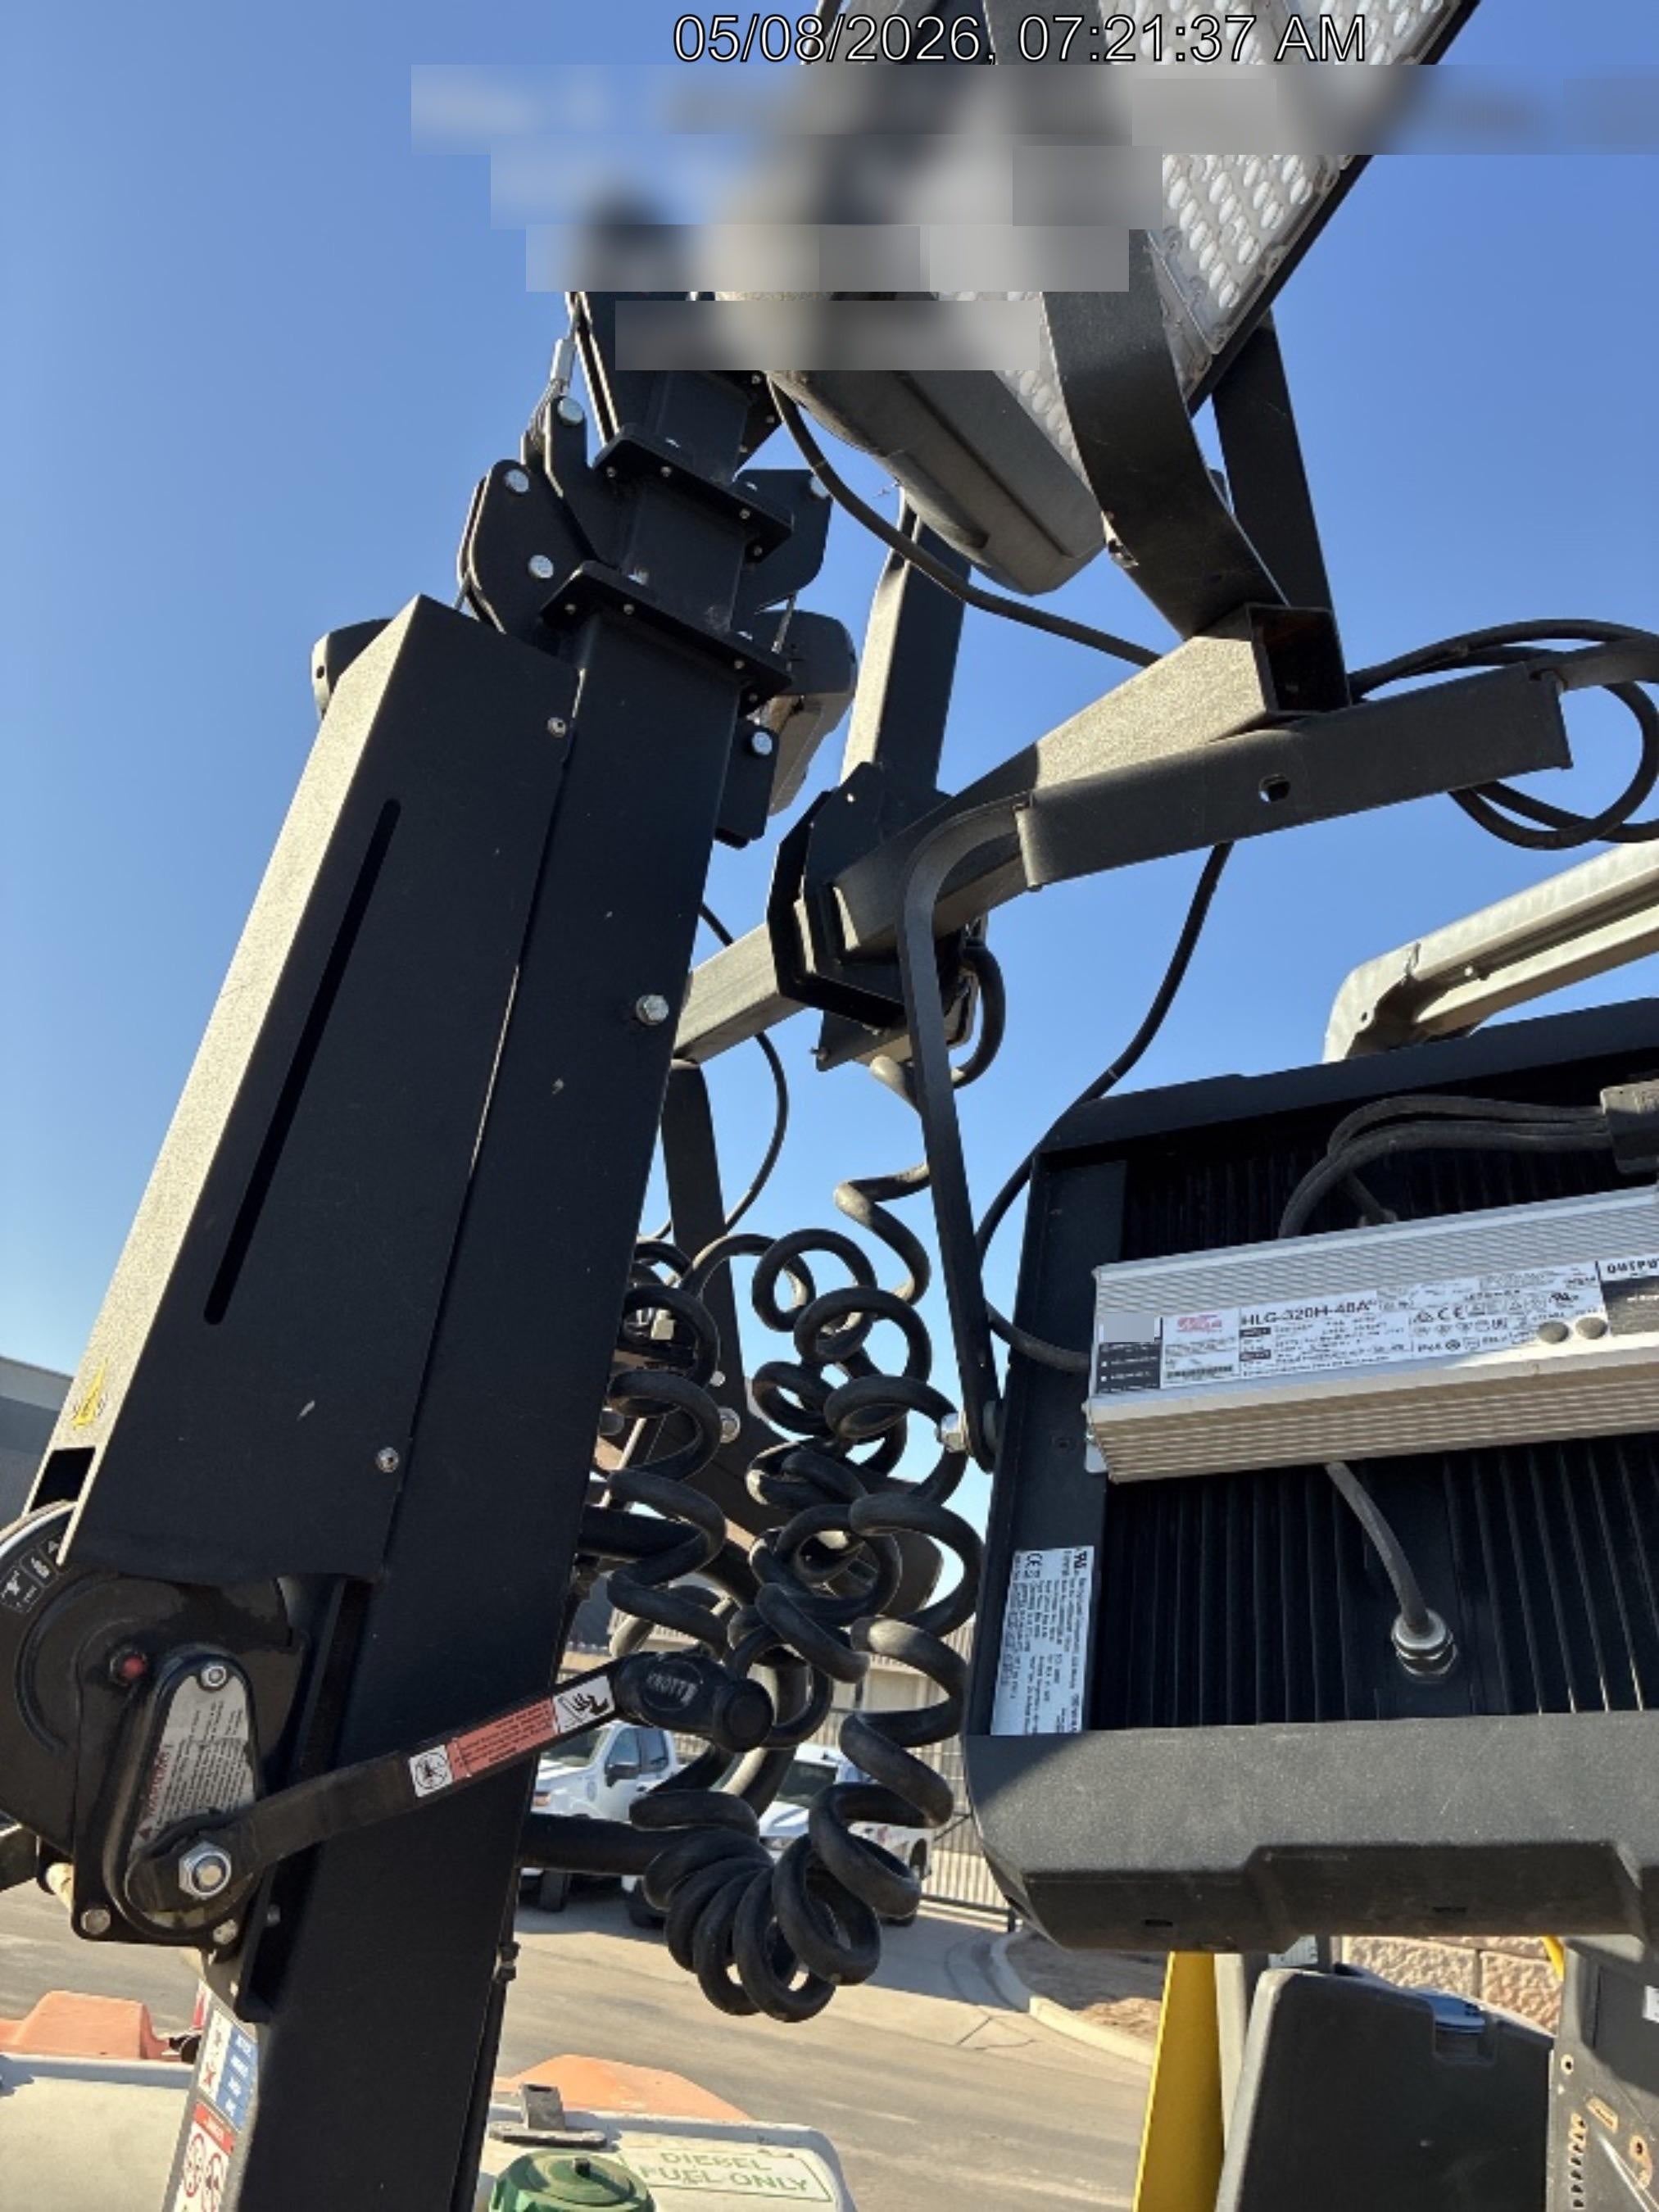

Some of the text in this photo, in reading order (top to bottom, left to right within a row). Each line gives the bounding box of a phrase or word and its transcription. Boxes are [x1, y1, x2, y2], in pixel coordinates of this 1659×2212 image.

[1607, 1258, 1659, 1274] OUTPU
[660, 2151, 772, 2171] DIESEL
[638, 2164, 808, 2192] FUEL ONLY
